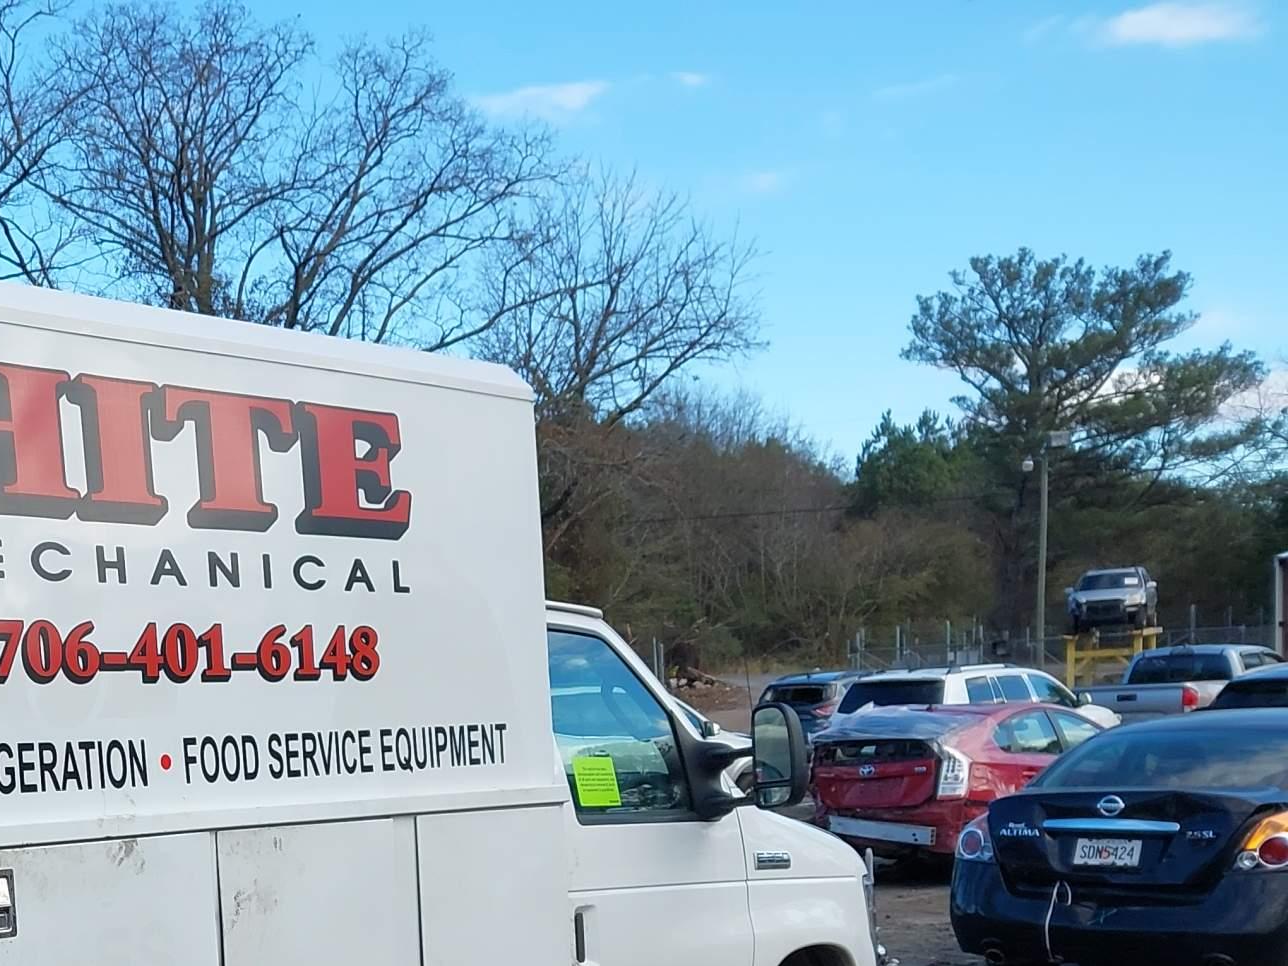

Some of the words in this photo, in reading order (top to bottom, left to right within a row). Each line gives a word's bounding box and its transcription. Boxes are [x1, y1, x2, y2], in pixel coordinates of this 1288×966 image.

[182, 734, 260, 784] FOOD
[268, 729, 374, 780] SERVICE
[379, 723, 508, 774] EQUIPMENT
[999, 828, 1040, 837] ALTIMA
